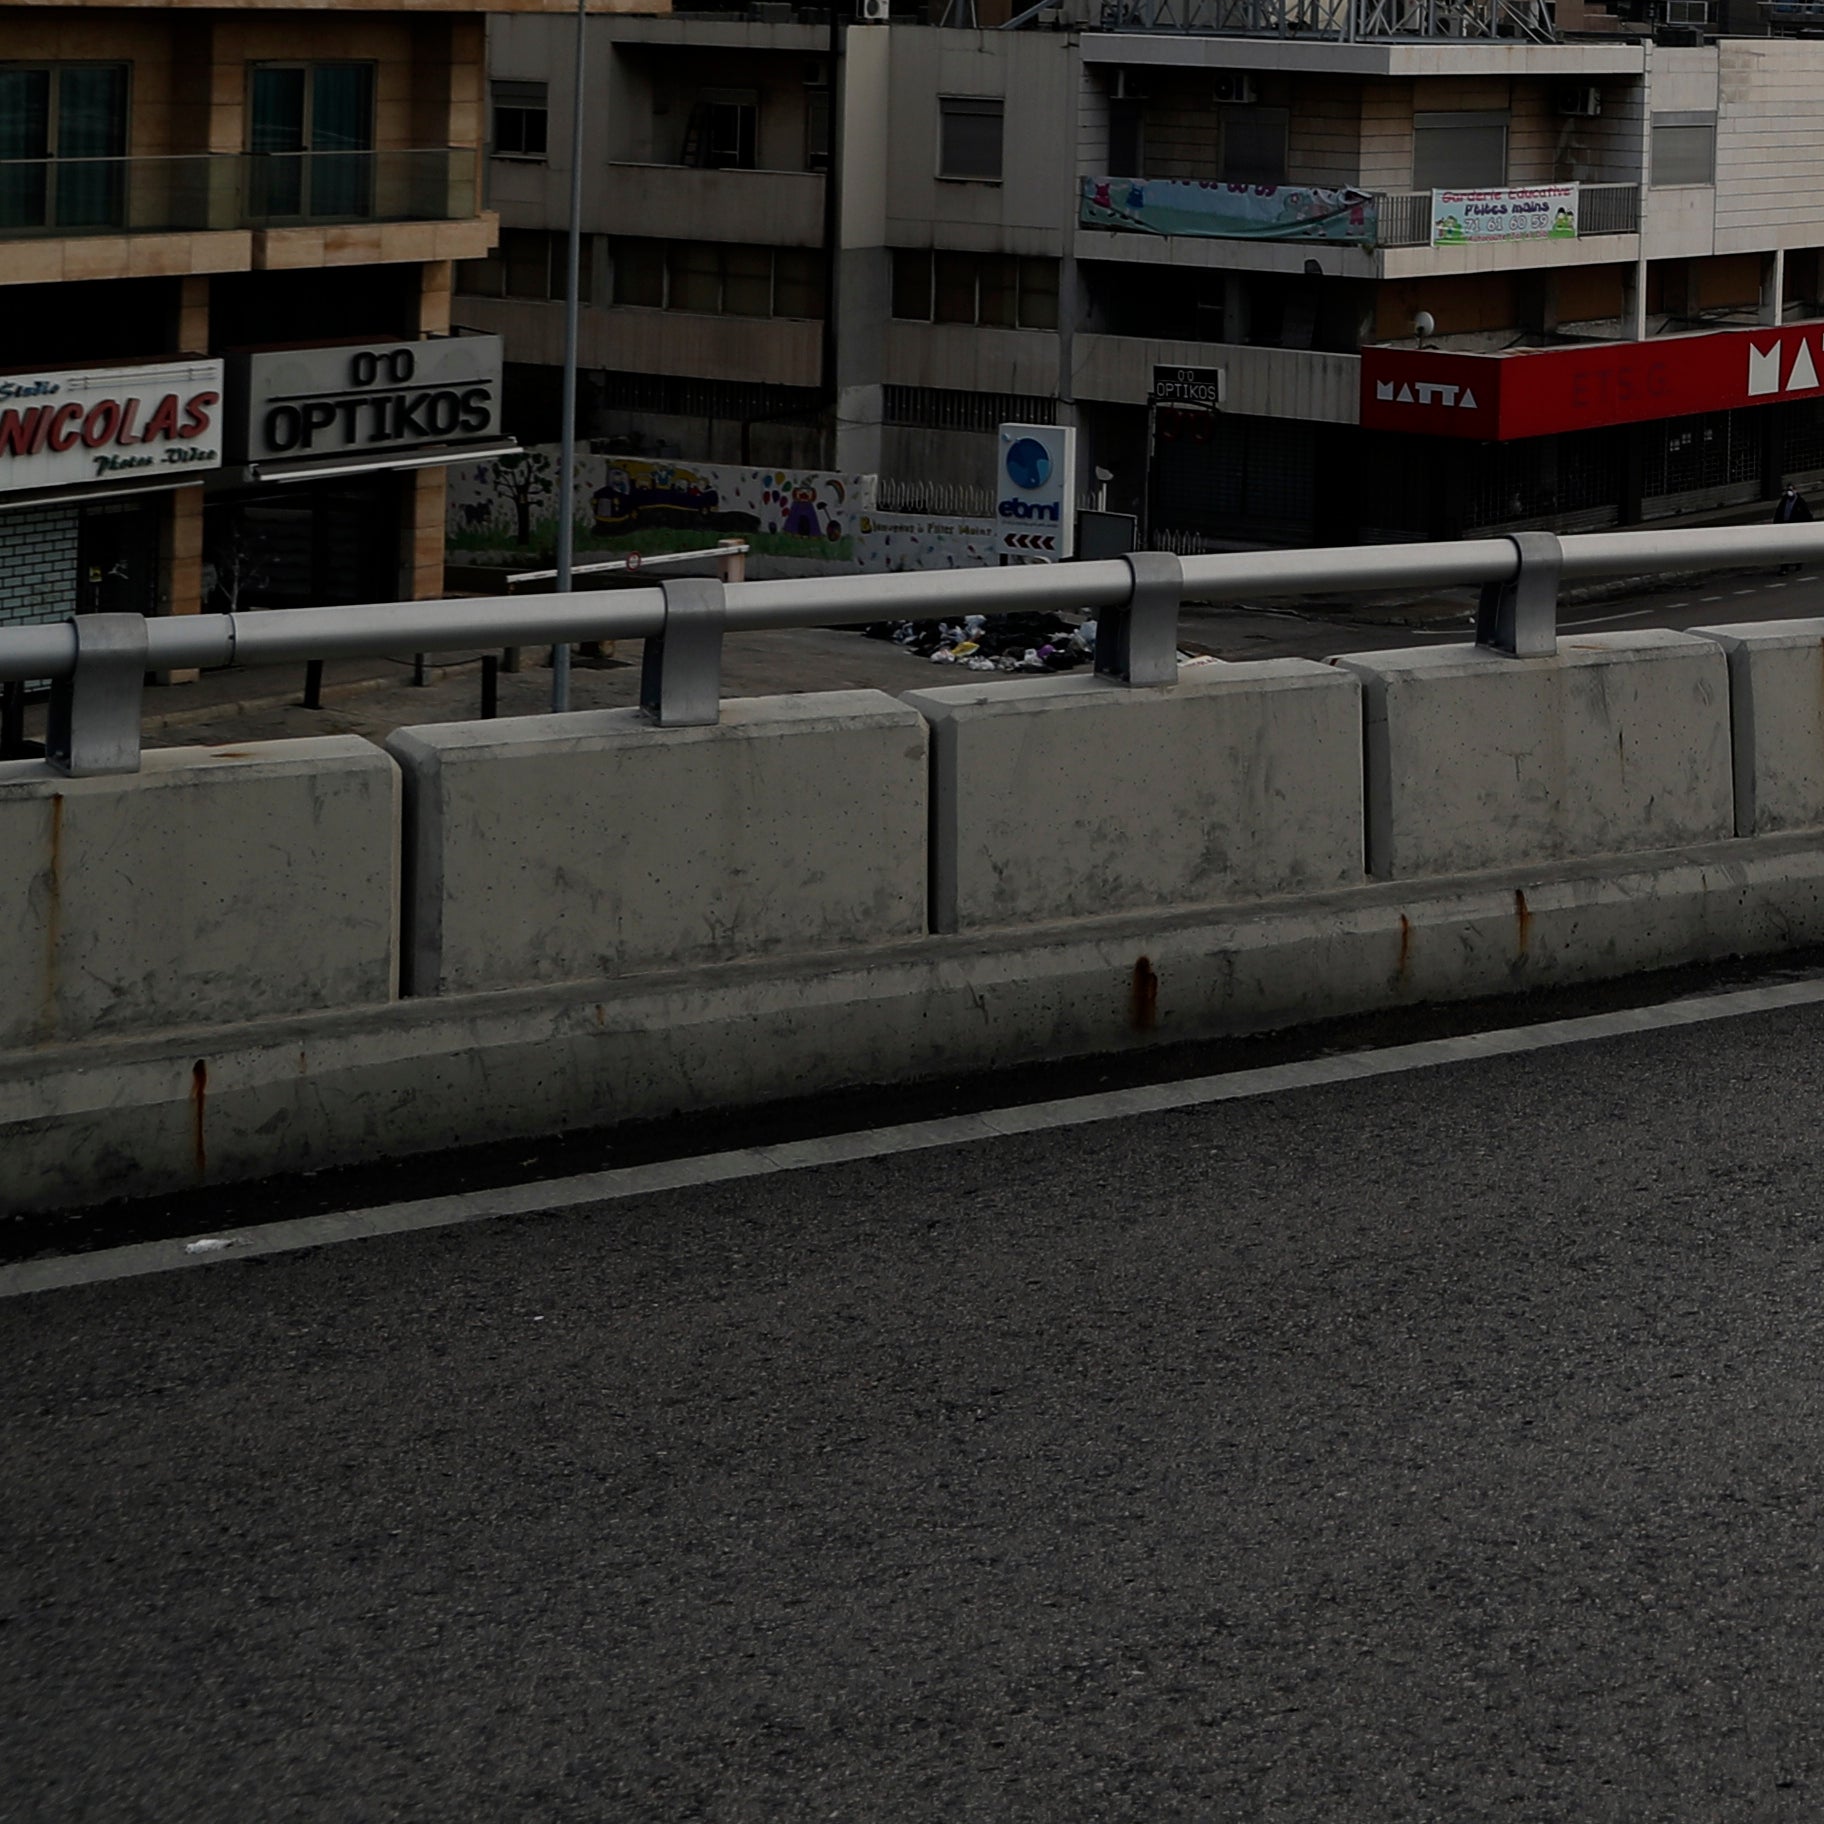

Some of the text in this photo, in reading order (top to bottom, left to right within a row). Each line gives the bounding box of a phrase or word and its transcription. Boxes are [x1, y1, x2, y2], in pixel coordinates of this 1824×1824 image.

[1464, 214, 1550, 233] 71 61 60 59
[1156, 382, 1217, 401] OPTIKOS
[1376, 379, 1479, 409] MATTA
[0, 391, 220, 458] NICOLAS
[265, 387, 493, 453] OPTIKOS
